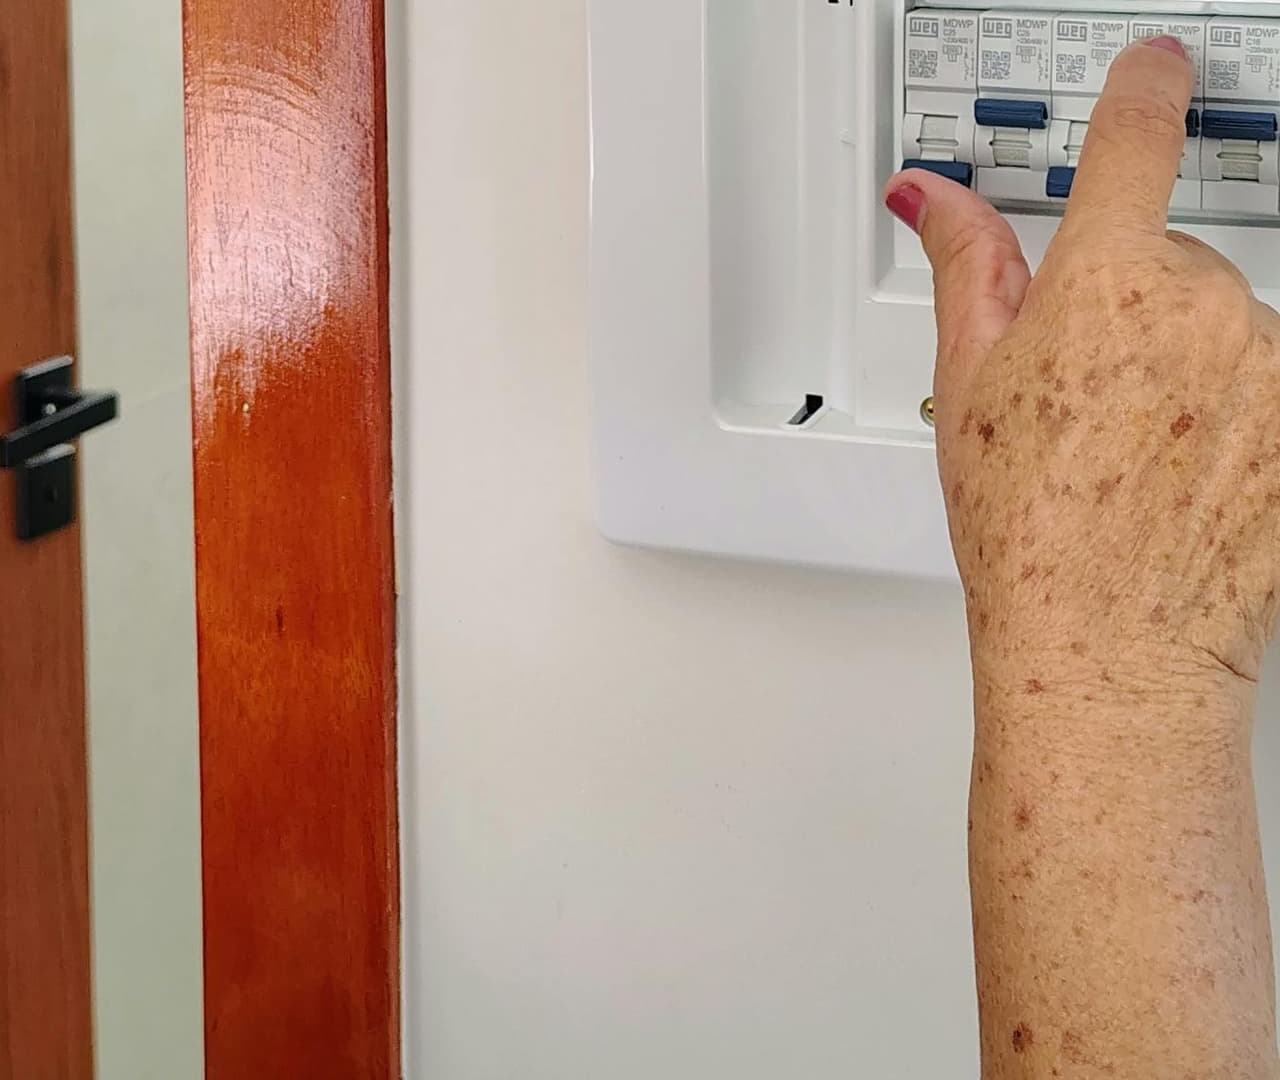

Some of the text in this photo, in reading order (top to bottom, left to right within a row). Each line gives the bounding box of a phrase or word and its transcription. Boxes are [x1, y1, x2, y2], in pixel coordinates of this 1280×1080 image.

[943, 18, 974, 28] MDWP
[1016, 19, 1048, 29] MDWP
[1092, 22, 1124, 33] MDWP
[1168, 24, 1200, 35] MDWP
[1246, 27, 1280, 38] MDWP
